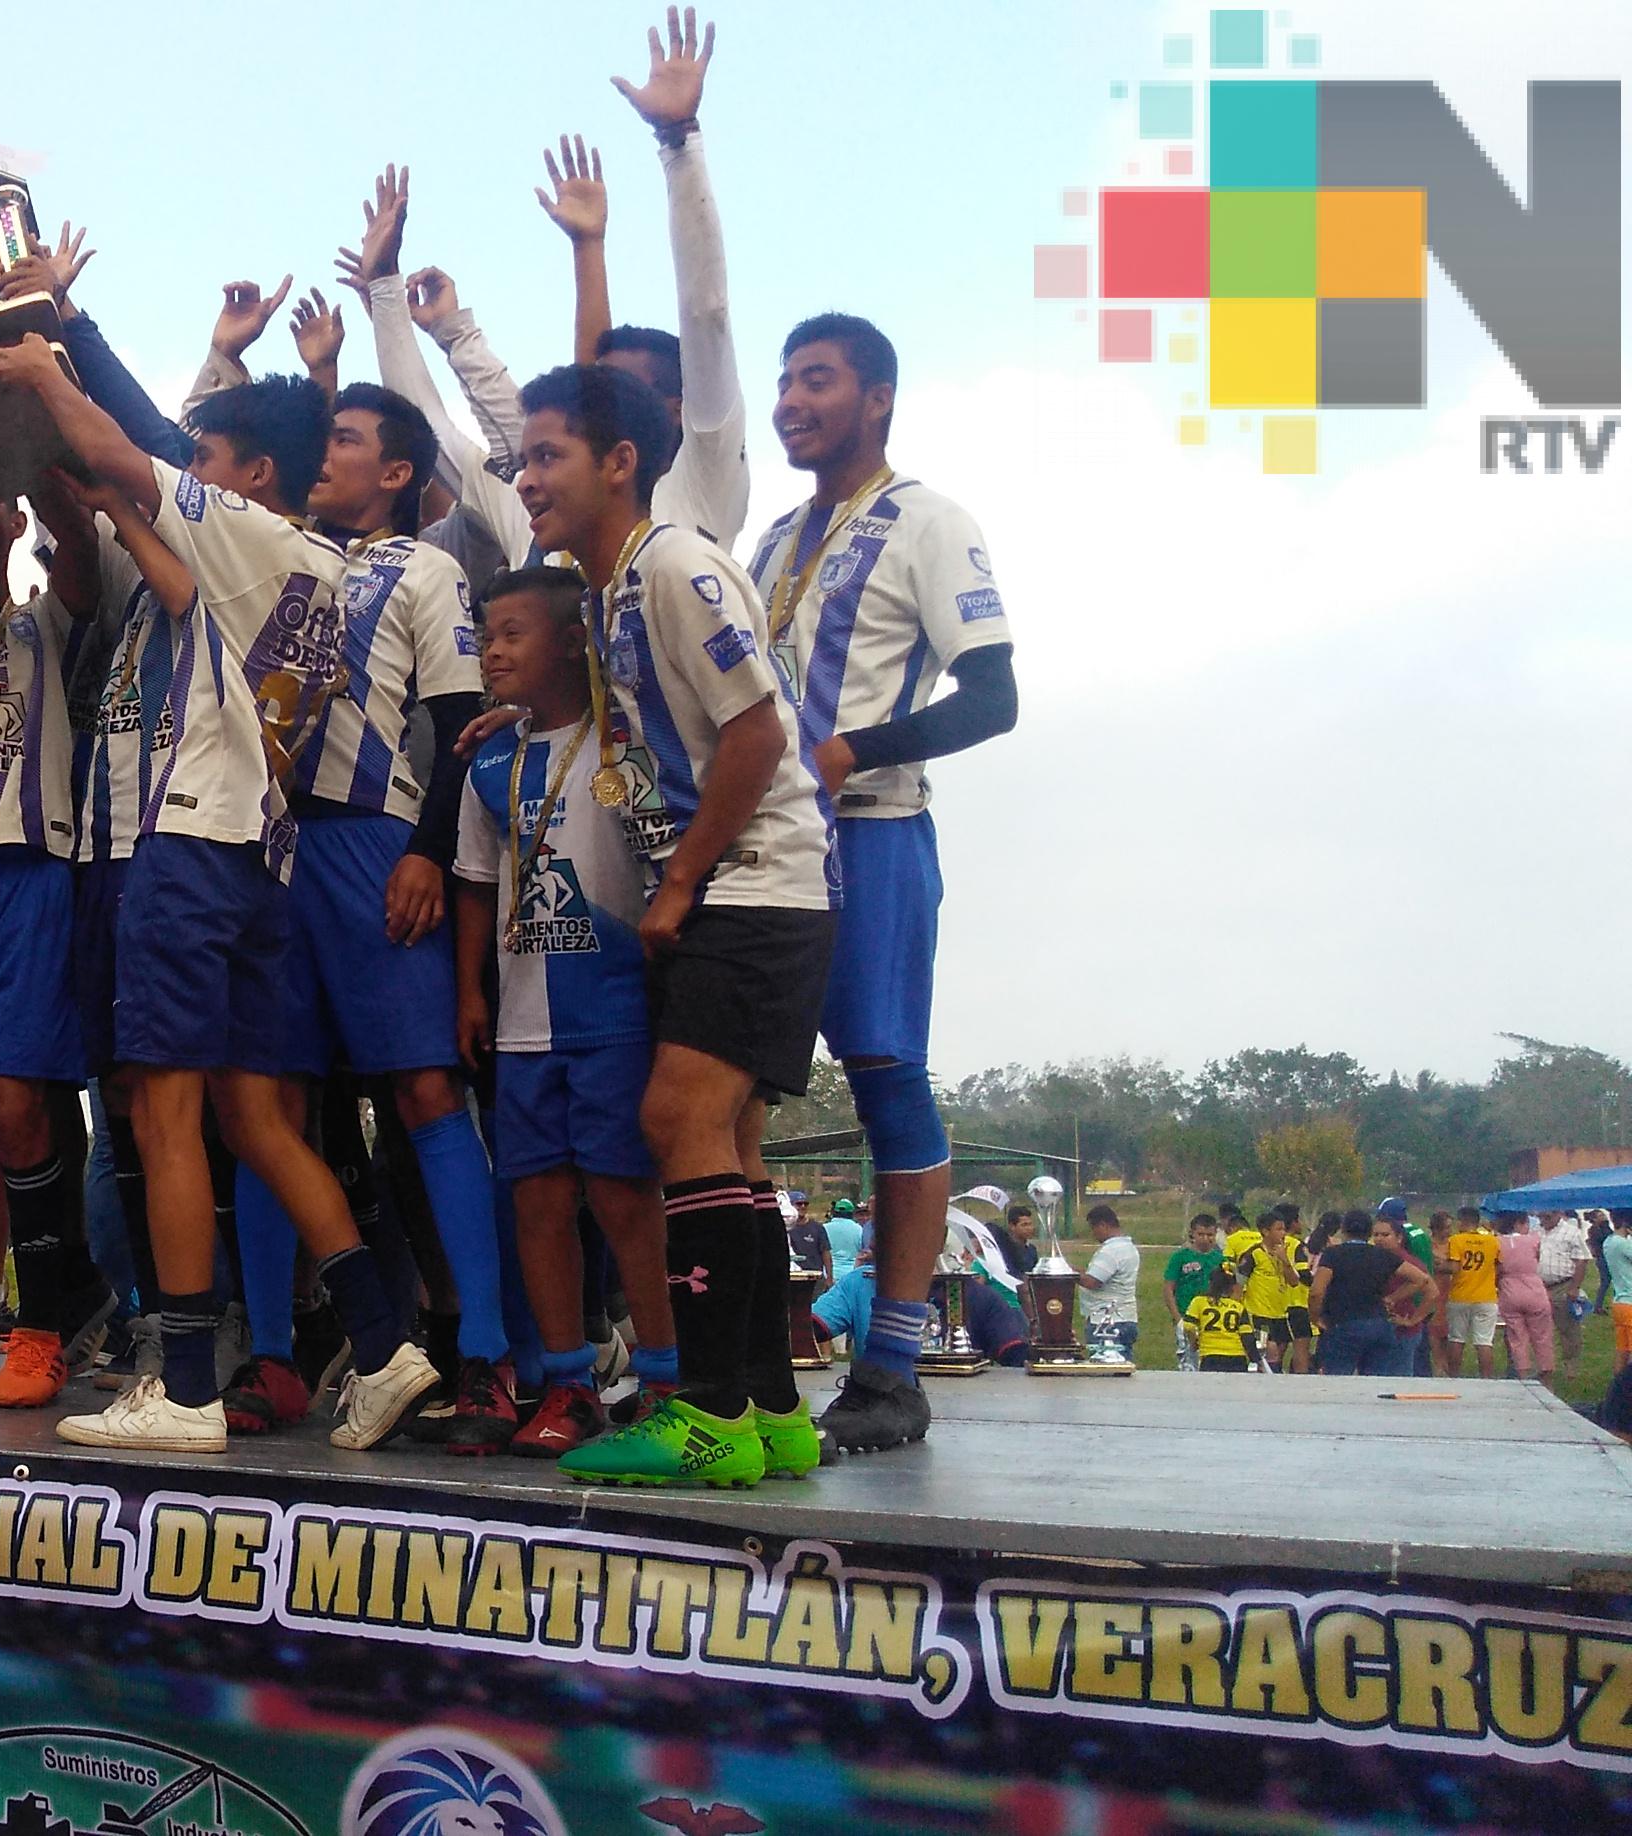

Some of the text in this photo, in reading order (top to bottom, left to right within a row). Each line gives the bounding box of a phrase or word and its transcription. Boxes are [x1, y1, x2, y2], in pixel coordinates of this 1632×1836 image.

[844, 516, 893, 536] telcel
[364, 548, 410, 565] telcel
[517, 919, 592, 939] EMENTOS
[513, 935, 599, 956] ORTALEZA
[1462, 1250, 1485, 1271] 29
[1202, 1308, 1241, 1333] 20
[678, 1442, 735, 1476] adidas
[144, 1503, 272, 1609] DE
[287, 1513, 960, 1706] MINATITLÁN,
[990, 1589, 1632, 1758] VERACRUZ
[43, 1746, 158, 1788] Suministros
